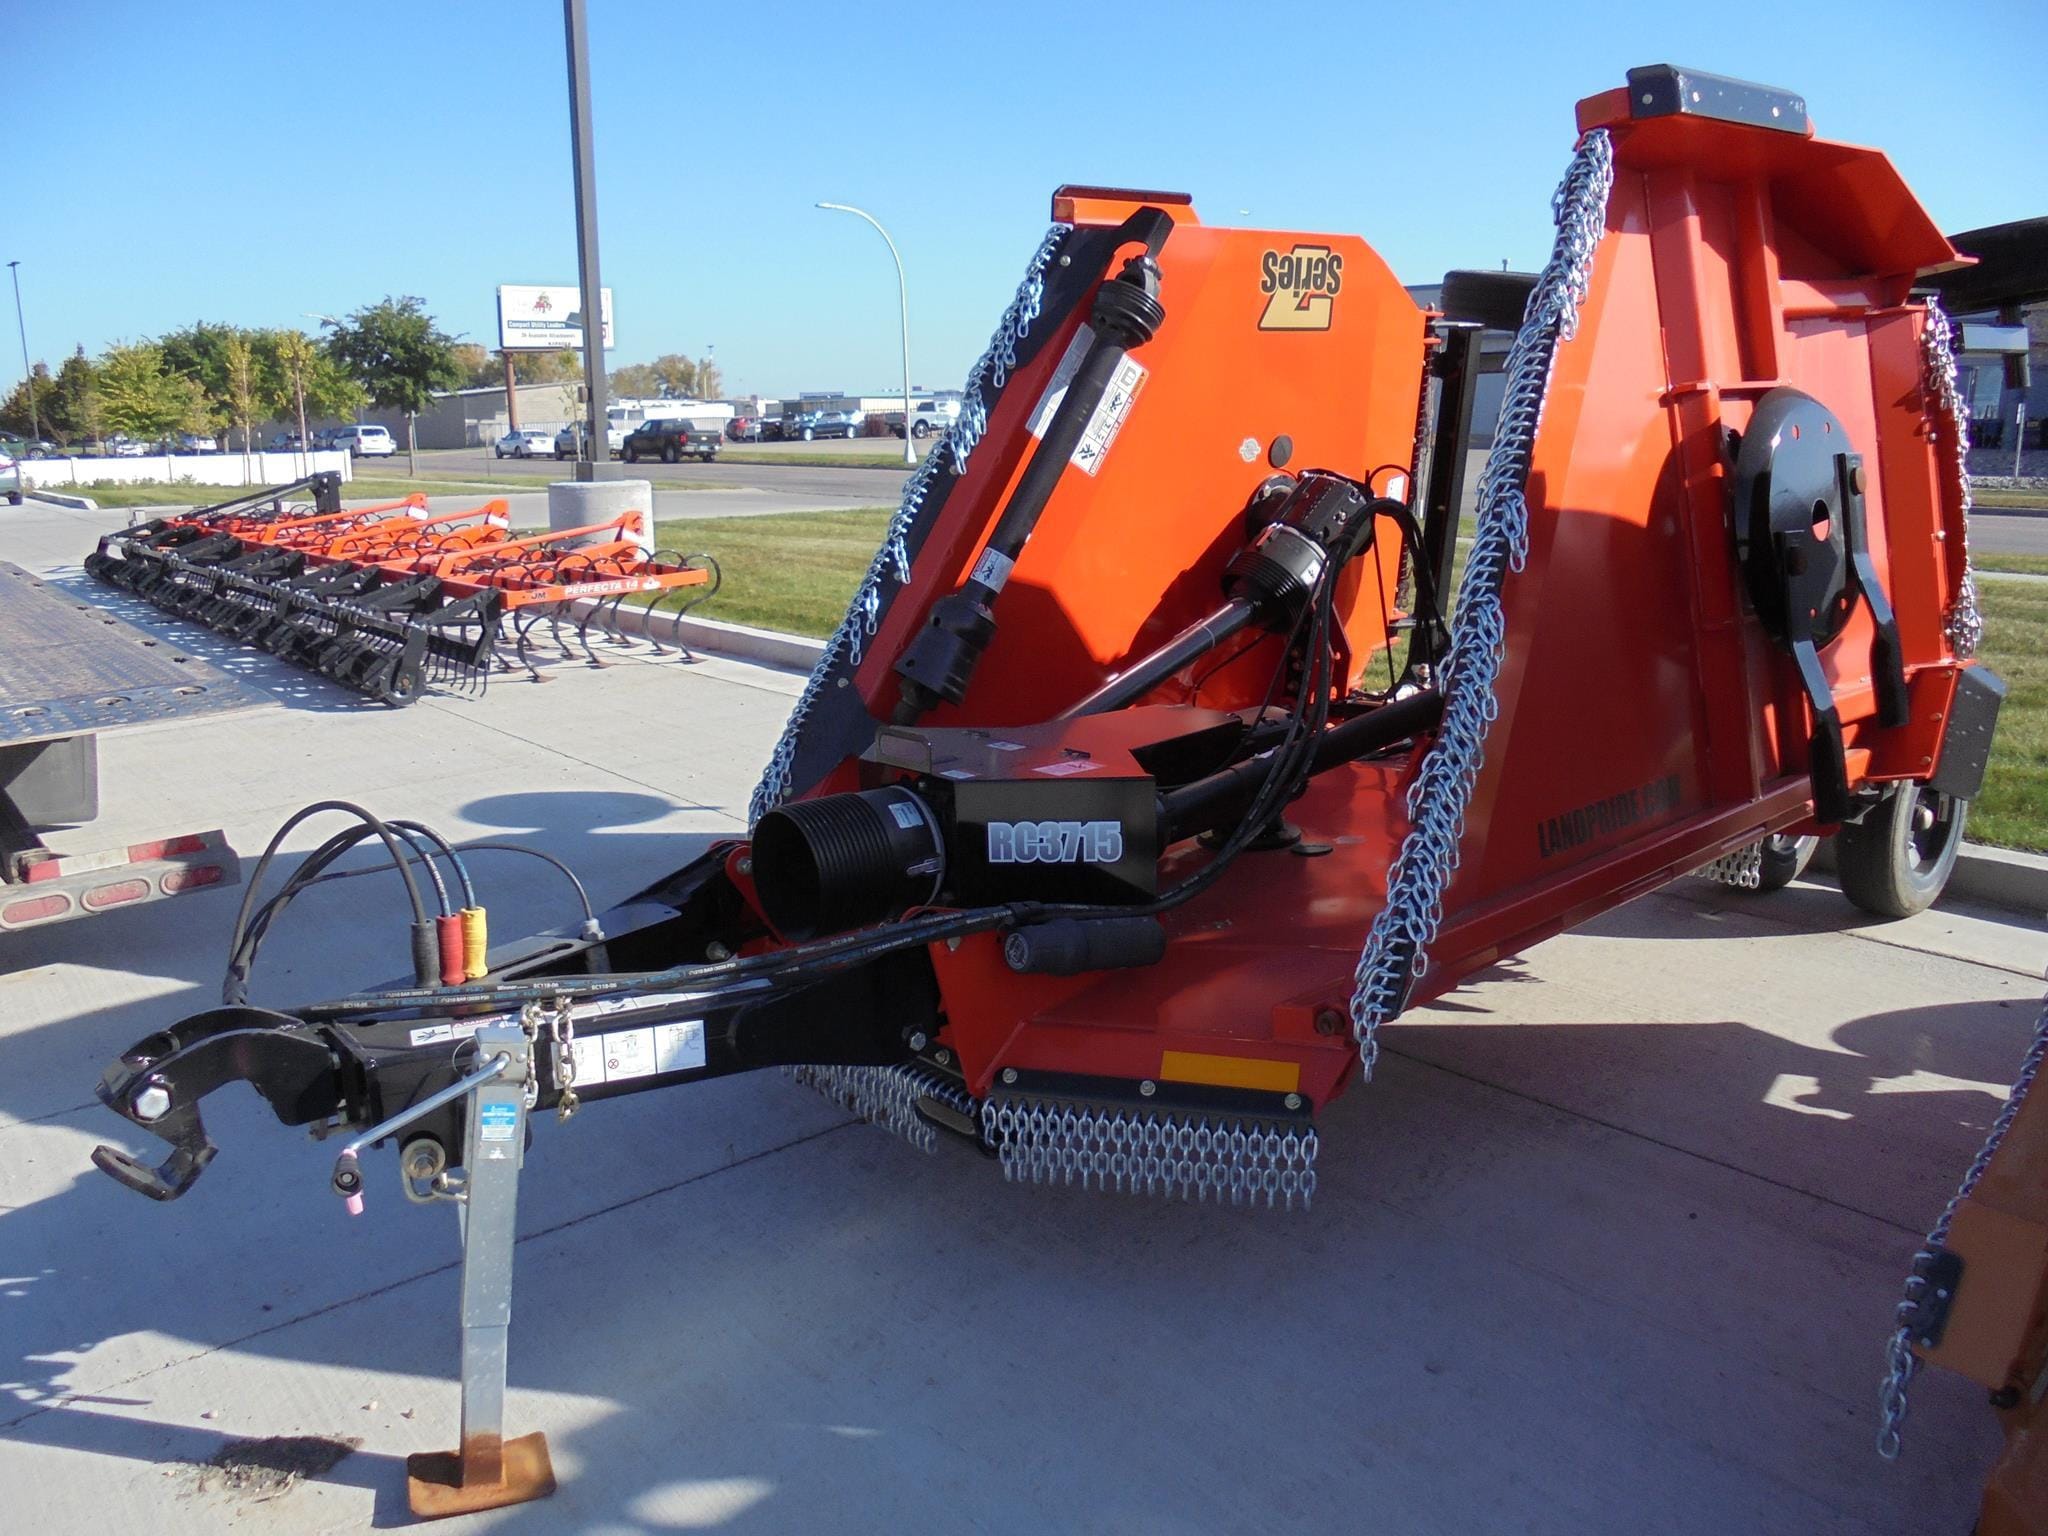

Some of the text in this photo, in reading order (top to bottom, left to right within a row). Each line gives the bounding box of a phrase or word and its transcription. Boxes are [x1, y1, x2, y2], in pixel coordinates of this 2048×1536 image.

[565, 580, 639, 595] PERFECTA 14
[987, 820, 1123, 864] RC3715
[463, 1016, 501, 1026] DANGER
